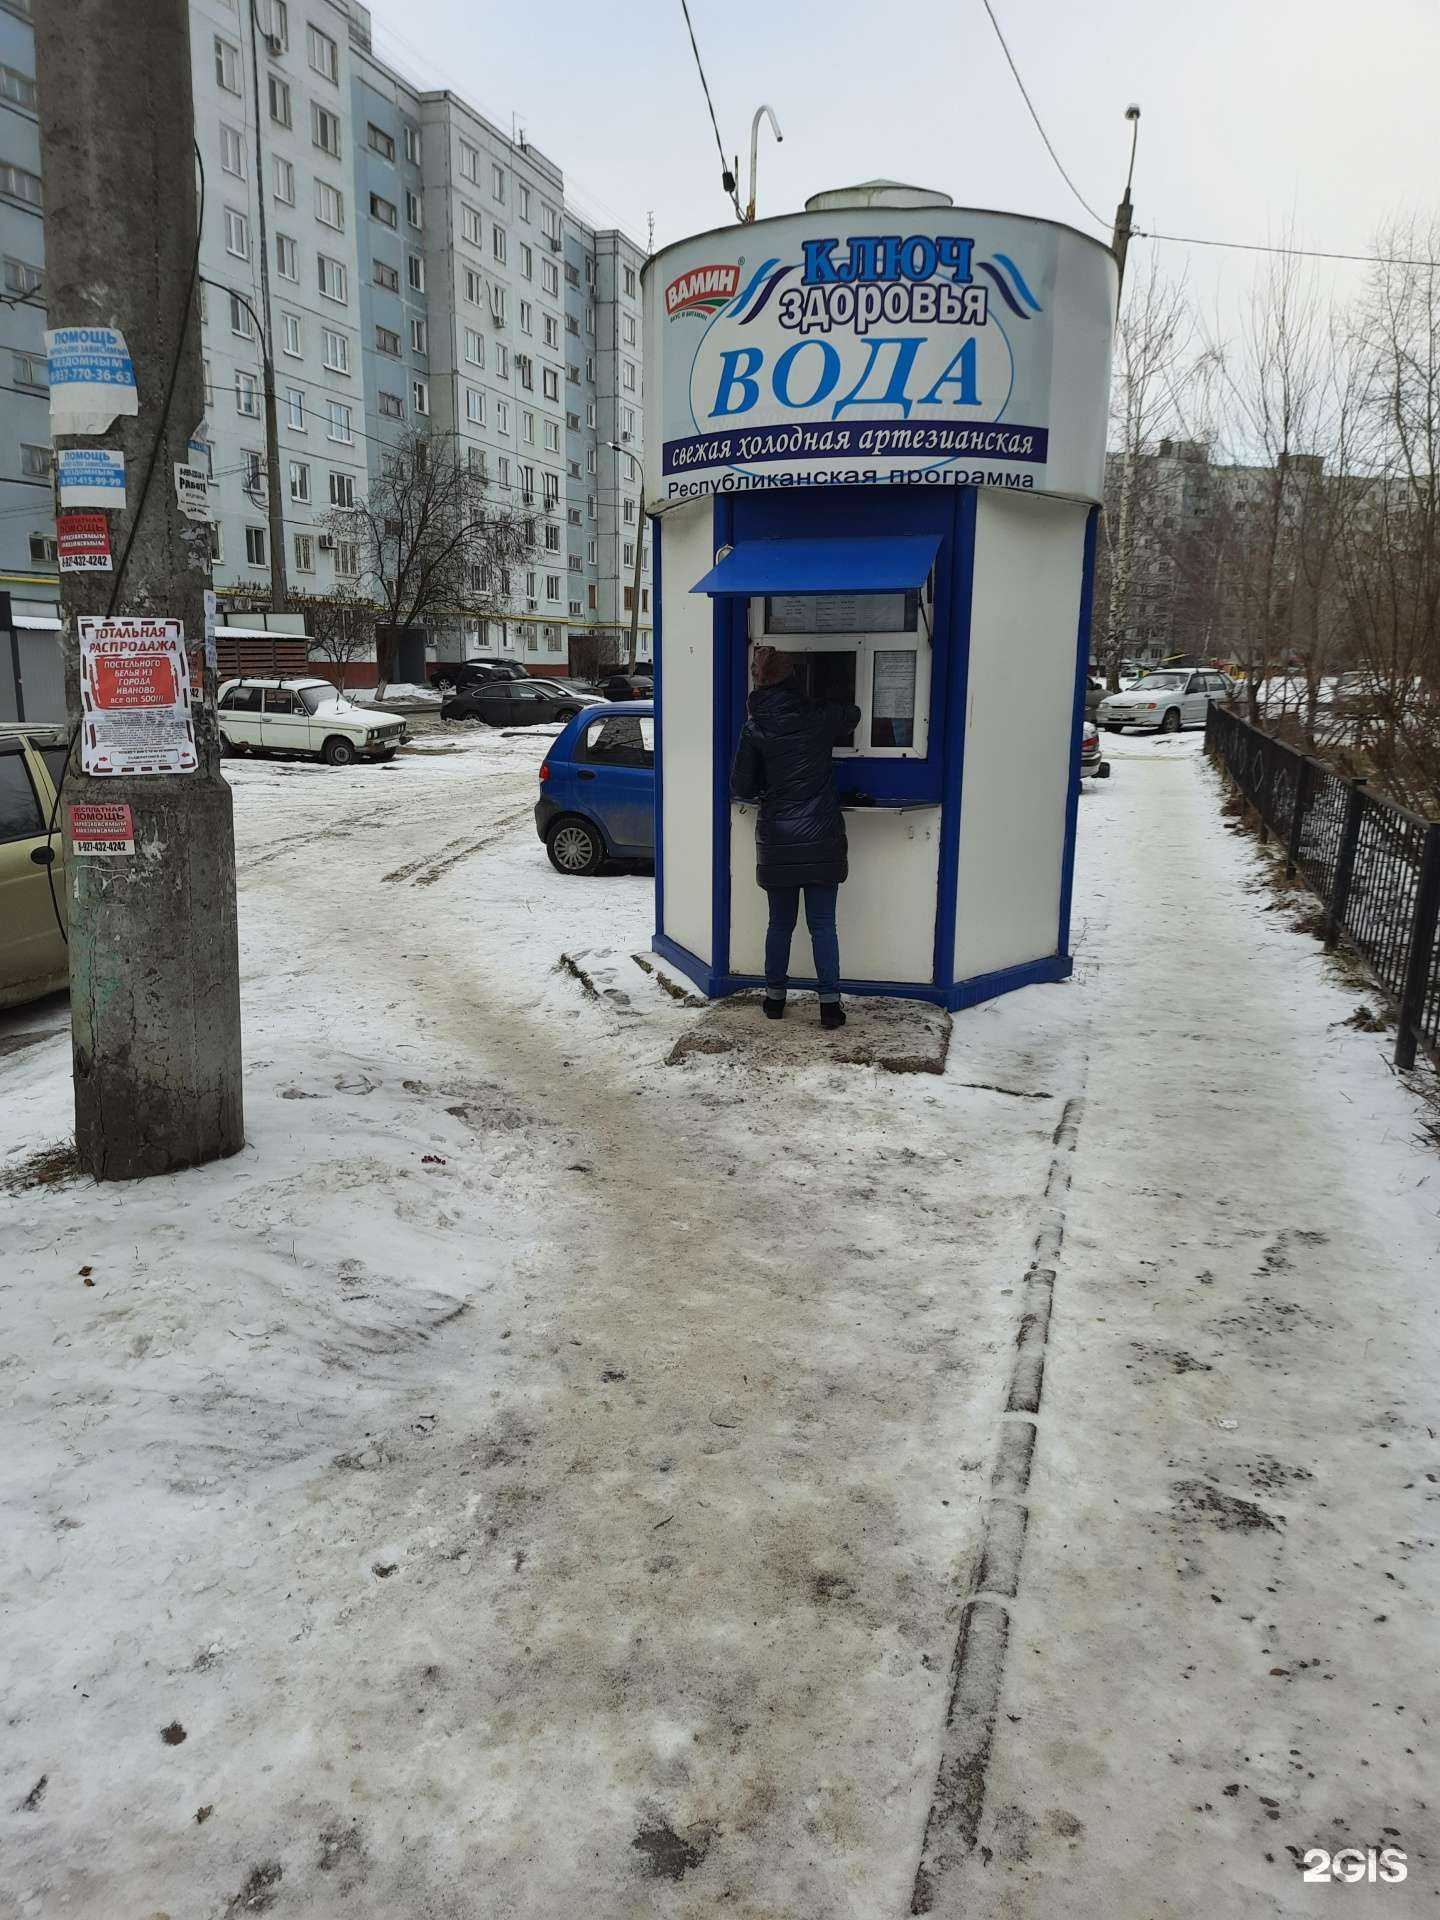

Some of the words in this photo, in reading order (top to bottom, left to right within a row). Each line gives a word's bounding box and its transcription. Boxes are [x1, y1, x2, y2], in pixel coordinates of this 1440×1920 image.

[801, 235, 975, 286] КЛЮЧ
[667, 268, 736, 310] ВАМИН
[779, 283, 988, 334] здоровья
[54, 330, 118, 345] ПОМОЩЬ
[707, 336, 983, 420] ВОДА
[672, 439, 732, 467] свежая
[736, 425, 851, 459] холодная
[858, 428, 1034, 456] артезианская
[64, 451, 111, 462] ПОМОЩЬ
[668, 468, 877, 499] Республиканская
[890, 469, 1034, 489] программа
[94, 626, 167, 640] ТОТАЛЬНАЯ
[88, 640, 177, 653] РАСПРОДАЖА
[104, 659, 161, 669] ПОСТЕЛЬНОГО
[114, 669, 140, 678] БЕЛЬЯ
[118, 678, 151, 686] ГОРОДА
[115, 686, 156, 695] ИВАНОВО
[125, 696, 138, 704] от
[73, 813, 126, 822] ПОМОЩЬ
